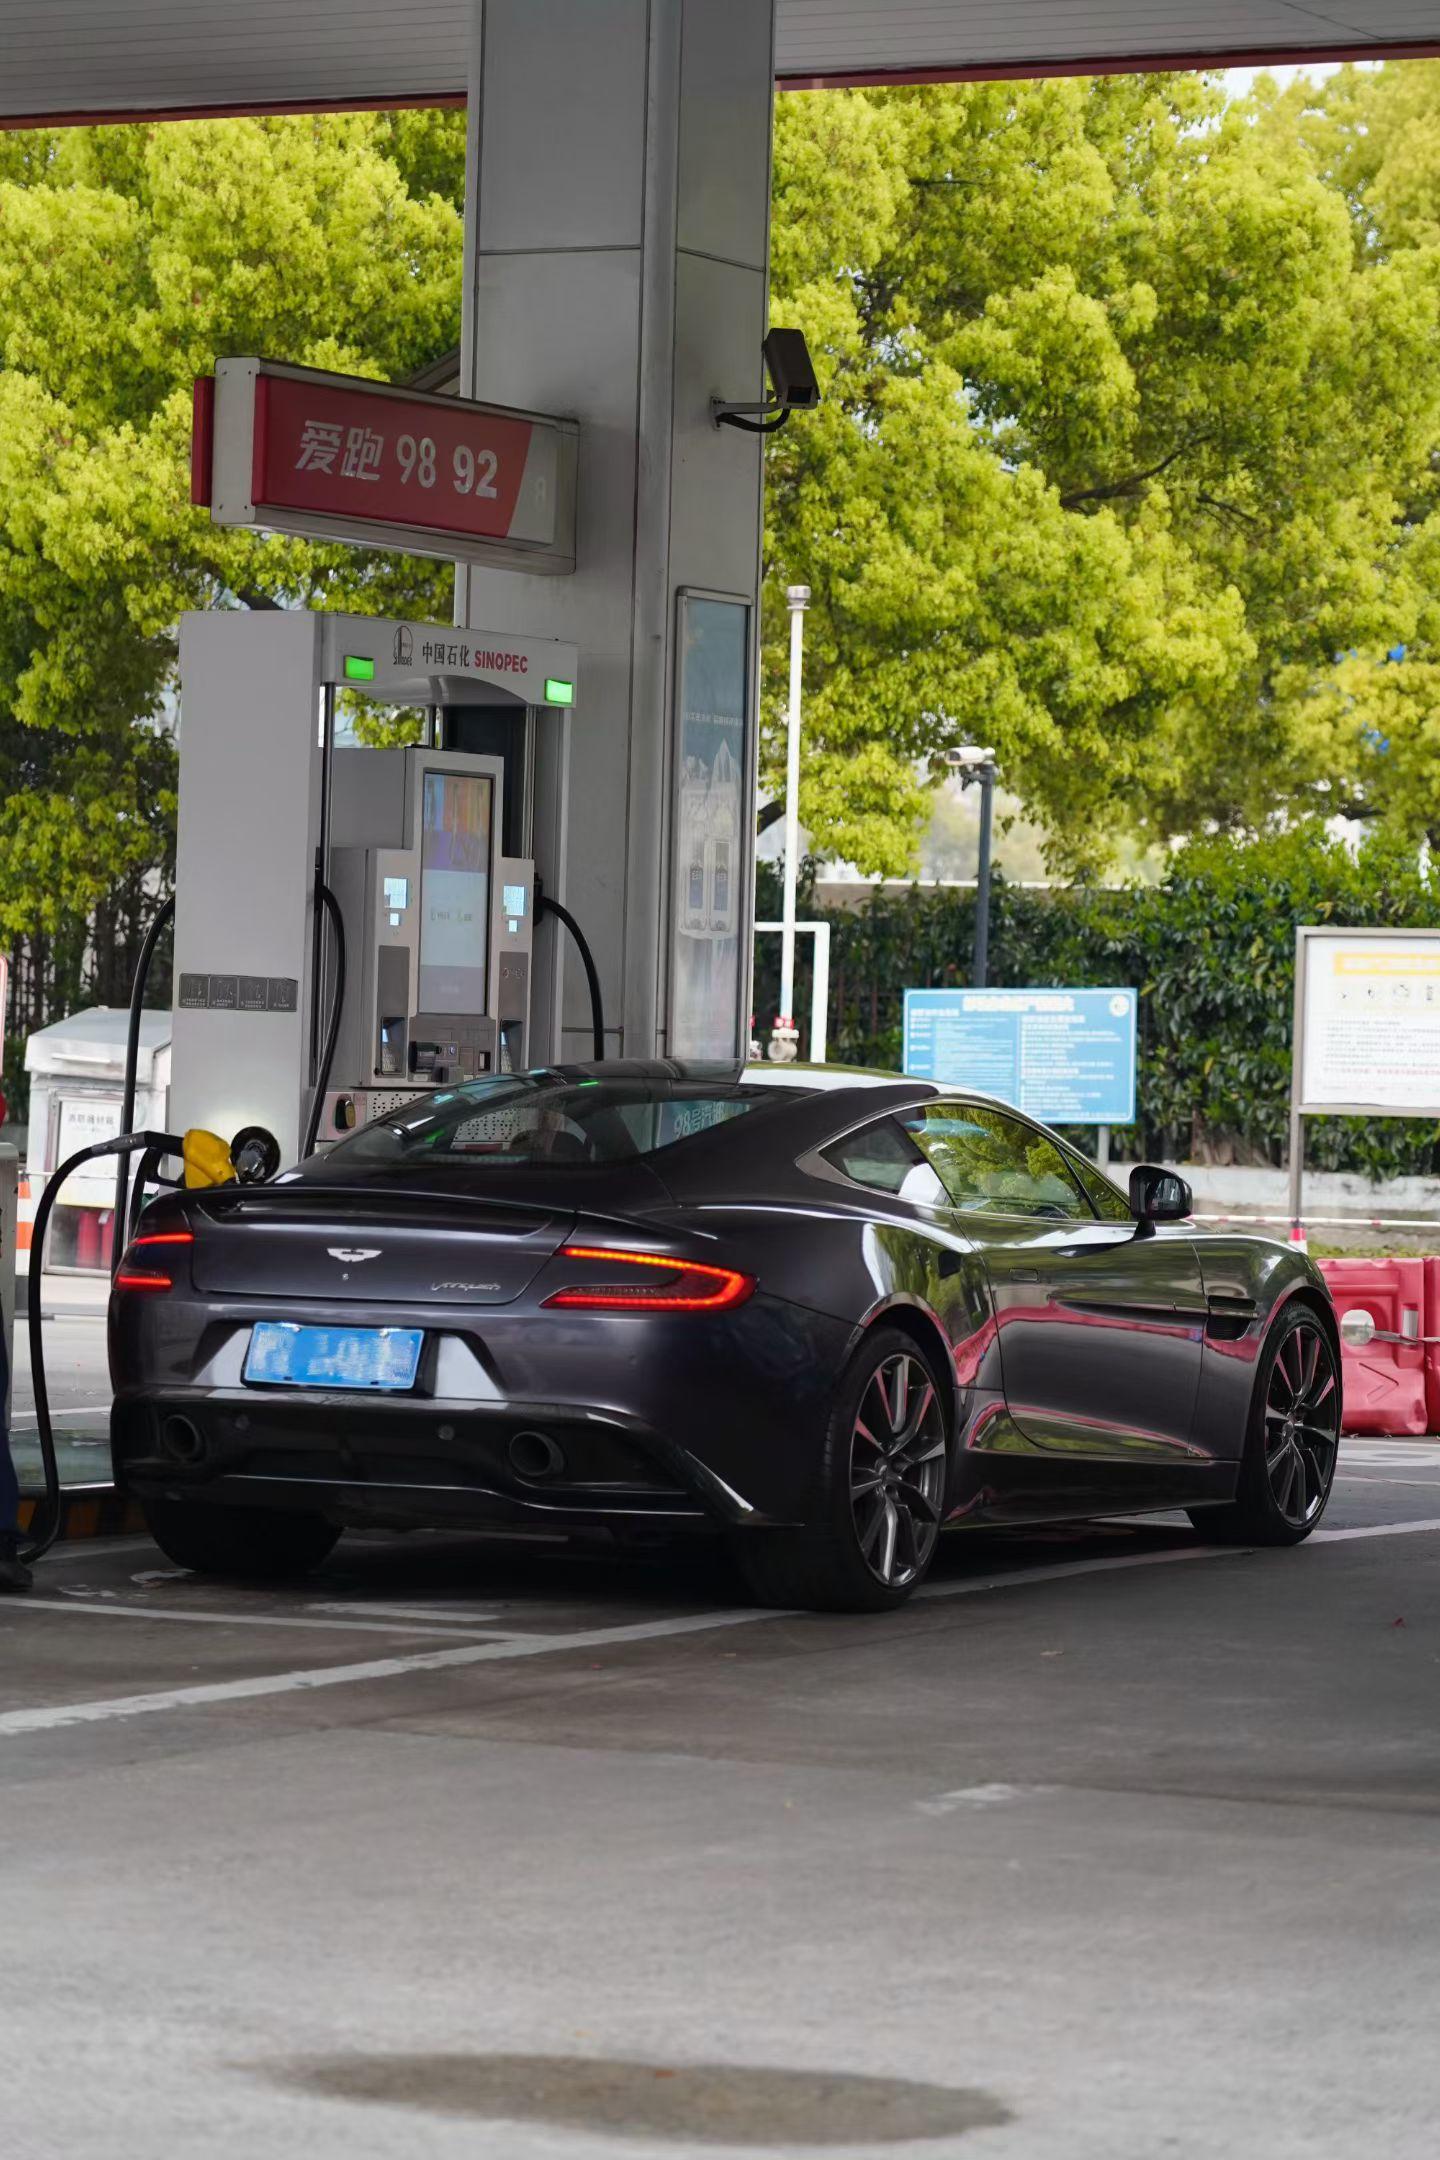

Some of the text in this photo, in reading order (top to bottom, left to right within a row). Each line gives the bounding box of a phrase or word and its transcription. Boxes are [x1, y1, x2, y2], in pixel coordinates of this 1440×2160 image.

[295, 420, 498, 499] 爱跑 98 92
[422, 641, 470, 667] 中国石化
[474, 650, 529, 674] SINOPEC
